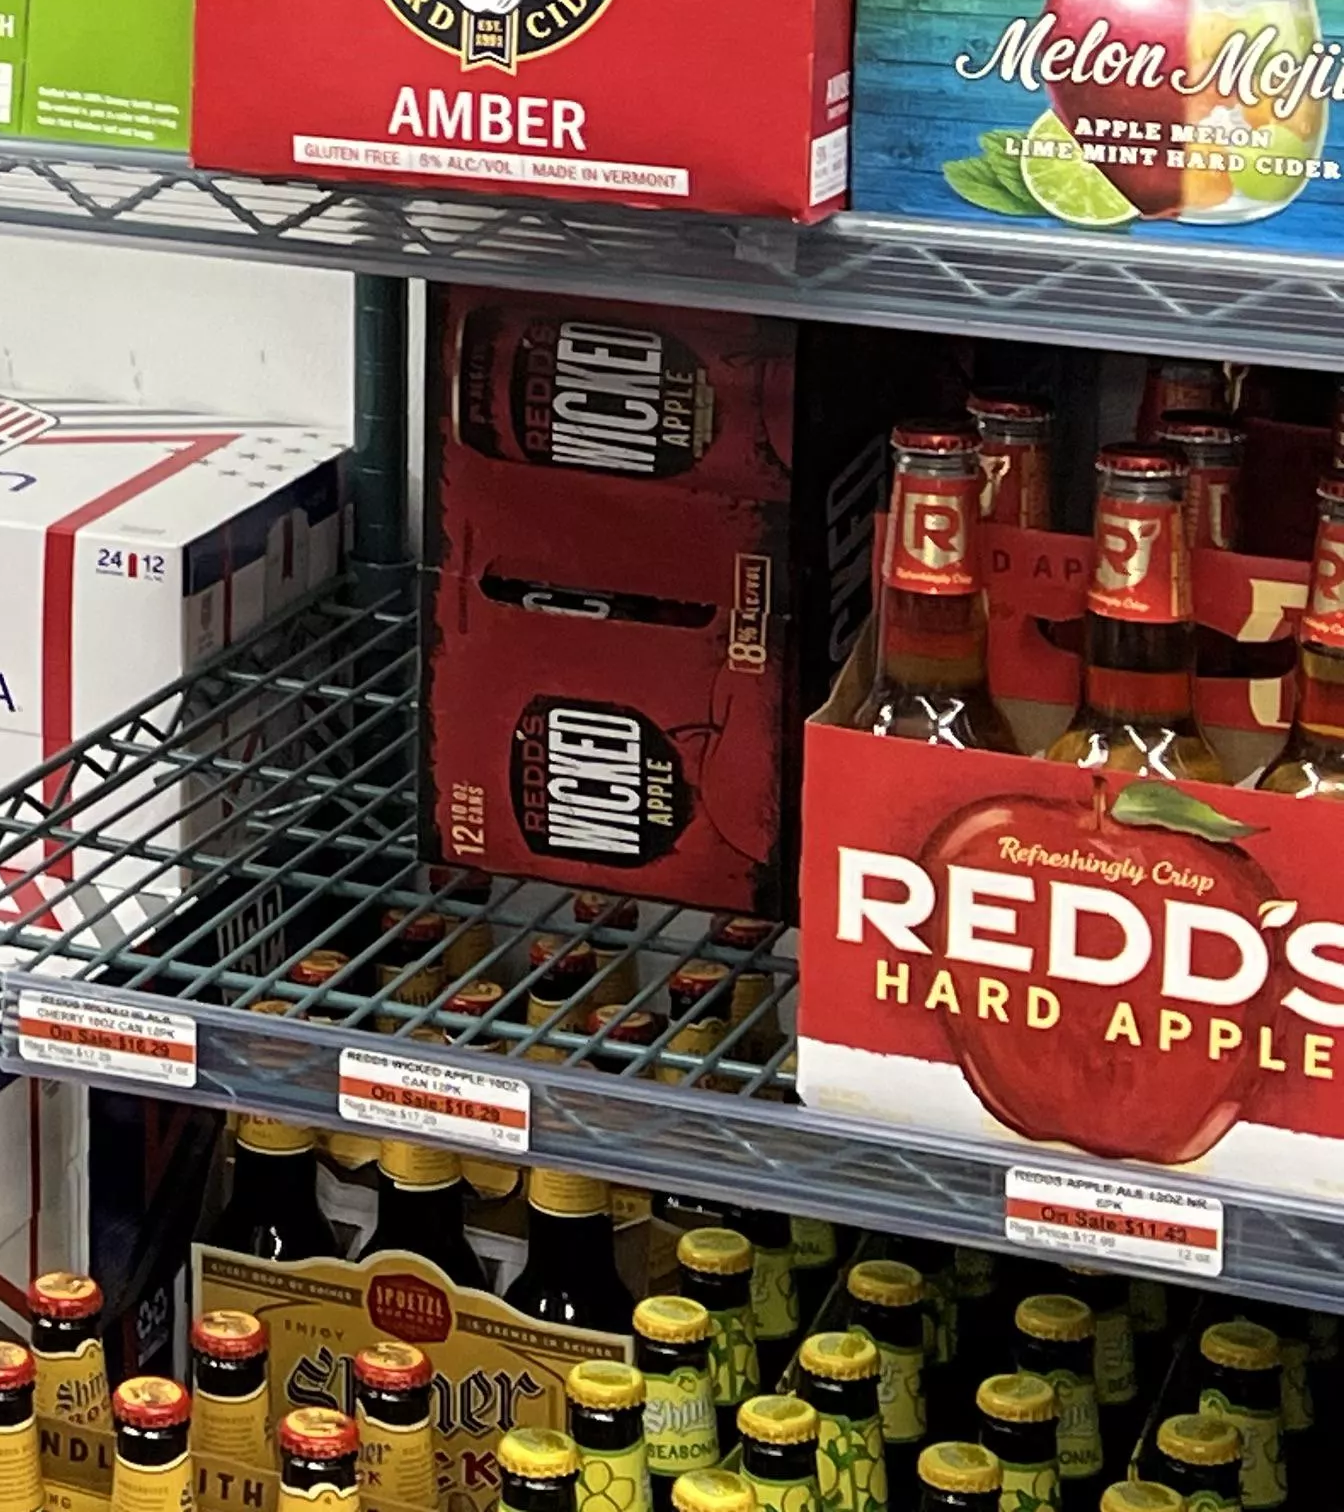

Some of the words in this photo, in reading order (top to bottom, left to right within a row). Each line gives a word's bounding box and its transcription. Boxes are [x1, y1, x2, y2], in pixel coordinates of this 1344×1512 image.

[954, 11, 1167, 93] Melon
[387, 85, 587, 152] AMBER
[1073, 117, 1162, 142] APPLE
[1170, 125, 1273, 150] MELON
[303, 141, 362, 164] GLUTEN
[364, 148, 402, 167] FREE
[447, 154, 513, 176] ALC/VOL
[531, 162, 578, 182] MADE
[602, 167, 677, 190] VERMONT
[1004, 137, 1076, 161] LIME
[1079, 141, 1158, 168] MINT
[1165, 148, 1246, 174] HARD
[1255, 158, 1343, 181] CIDER
[551, 319, 663, 473] WICKED
[661, 366, 696, 449] APPLE
[96, 547, 123, 569] 24
[142, 555, 165, 575] 12
[548, 706, 642, 855] WICKED
[646, 757, 674, 828] APPLE
[454, 823, 486, 857] 12
[996, 835, 1147, 884] Refreshingly
[1151, 861, 1215, 896] Crisp
[37, 1007, 85, 1024] CHERRY
[117, 1021, 144, 1034] CAN
[49, 1024, 74, 1041] On
[875, 959, 1061, 1031] HARD
[1105, 1001, 1335, 1080] APPLE
[347, 1051, 389, 1067] REDDS
[392, 1059, 442, 1078] WICKED
[444, 1068, 486, 1087] APPLE
[401, 1074, 428, 1089] CAN
[371, 1085, 397, 1102] On
[1066, 1177, 1113, 1195] APPLE
[1041, 1205, 1069, 1223] On
[283, 1320, 345, 1343] ENJOY
